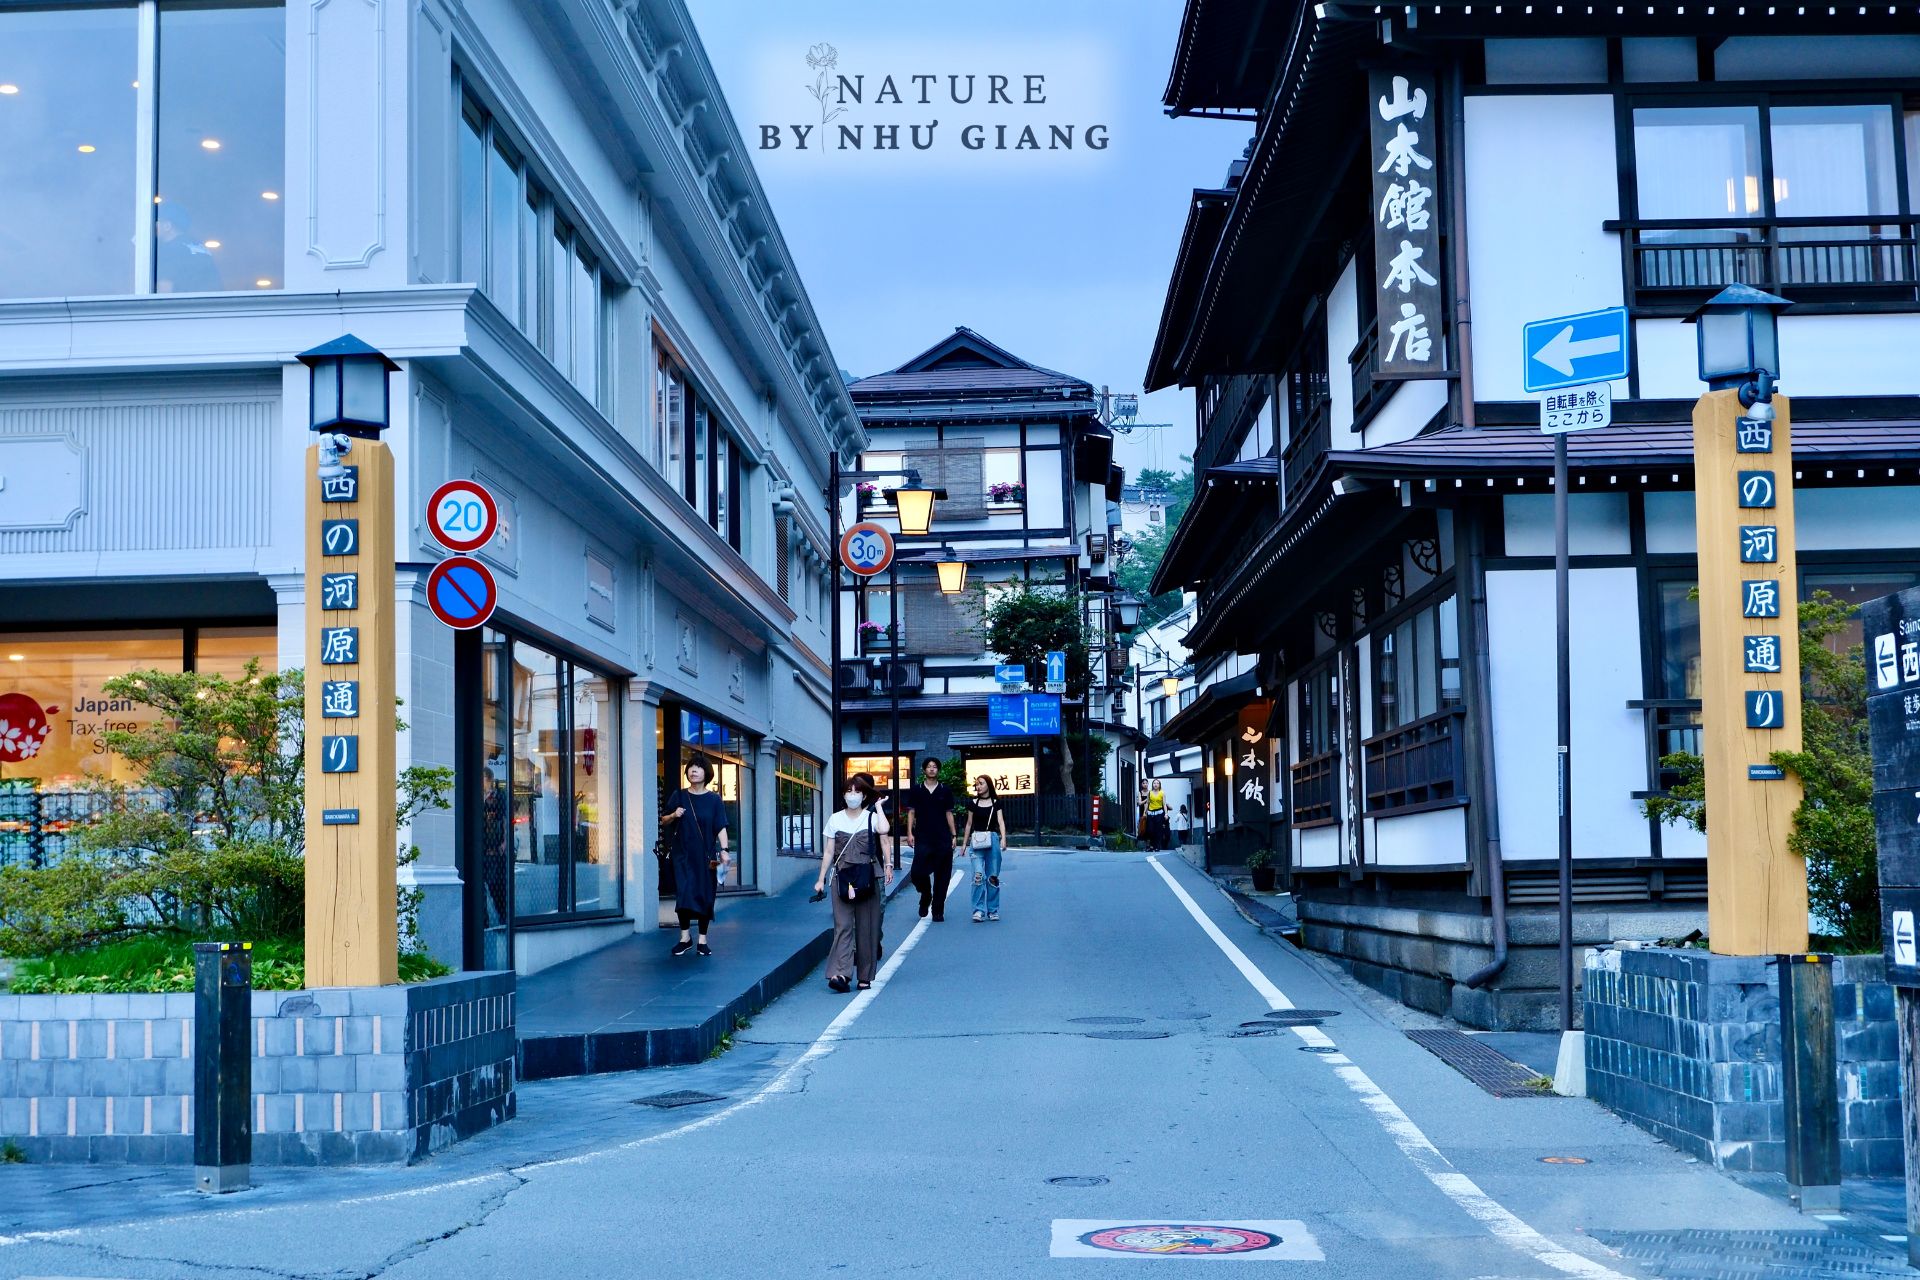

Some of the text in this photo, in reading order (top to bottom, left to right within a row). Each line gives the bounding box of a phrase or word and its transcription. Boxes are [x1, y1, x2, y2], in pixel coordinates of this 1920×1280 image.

[1378, 75, 1438, 363] 山本館本店
[1546, 391, 1605, 411] 自転車を除く
[1547, 409, 1604, 428] ここから
[443, 500, 482, 532] 20
[1738, 420, 1780, 727] 西の河原通り
[323, 469, 356, 772] 西の河原通り
[1901, 642, 1920, 683] 西
[75, 697, 137, 716] Japan.
[66, 719, 137, 735] Tax-free
[973, 775, 1031, 791] 成屋
